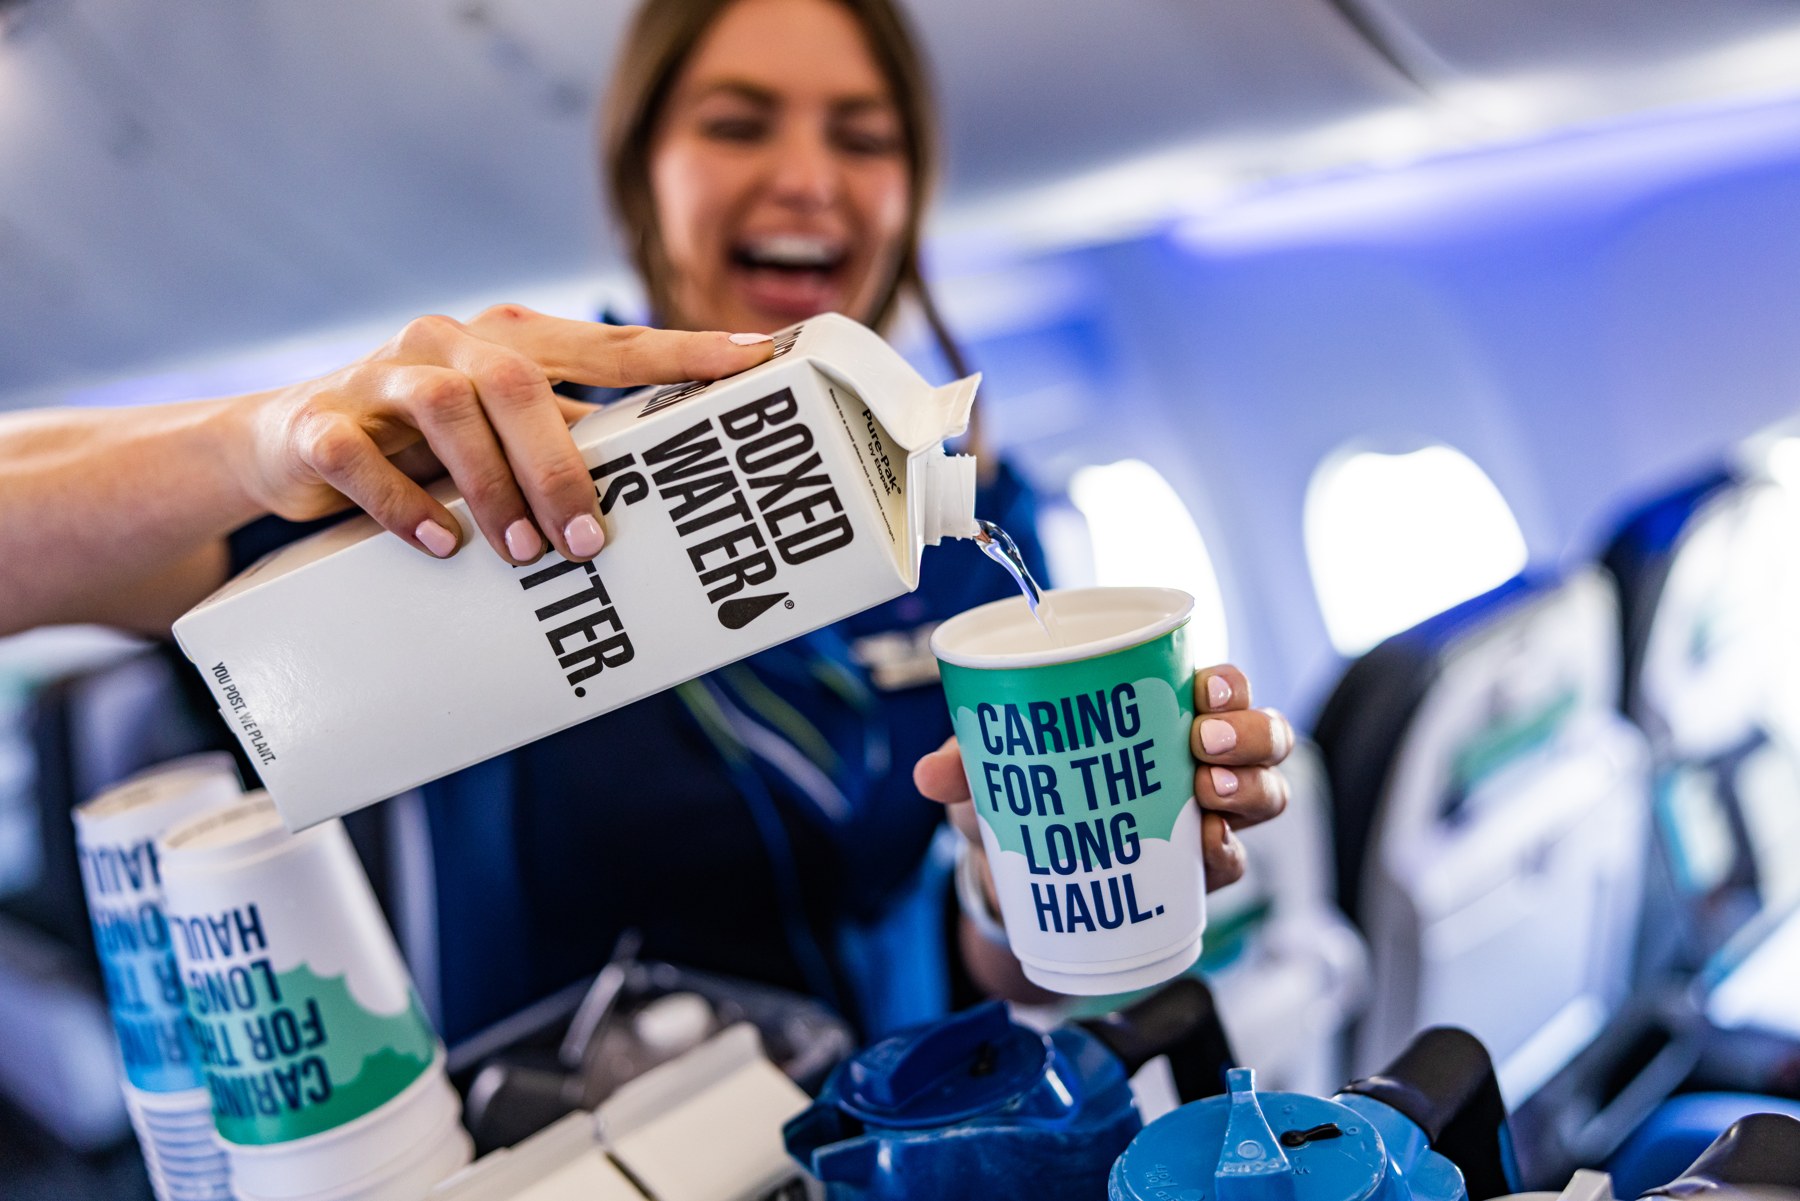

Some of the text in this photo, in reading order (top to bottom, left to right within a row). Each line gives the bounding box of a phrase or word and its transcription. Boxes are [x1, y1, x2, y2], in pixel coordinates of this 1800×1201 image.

[718, 386, 855, 565] BOXED
[868, 442, 891, 497] by Elopak
[517, 557, 635, 698] TTER.
[212, 661, 276, 766] YOU POST. WE PLANT.
[976, 682, 1141, 756] CARING
[981, 738, 1162, 817] FOR THE
[1019, 812, 1142, 876] LONG
[1030, 873, 1165, 933] HAUL.
[244, 998, 328, 1063] FOR
